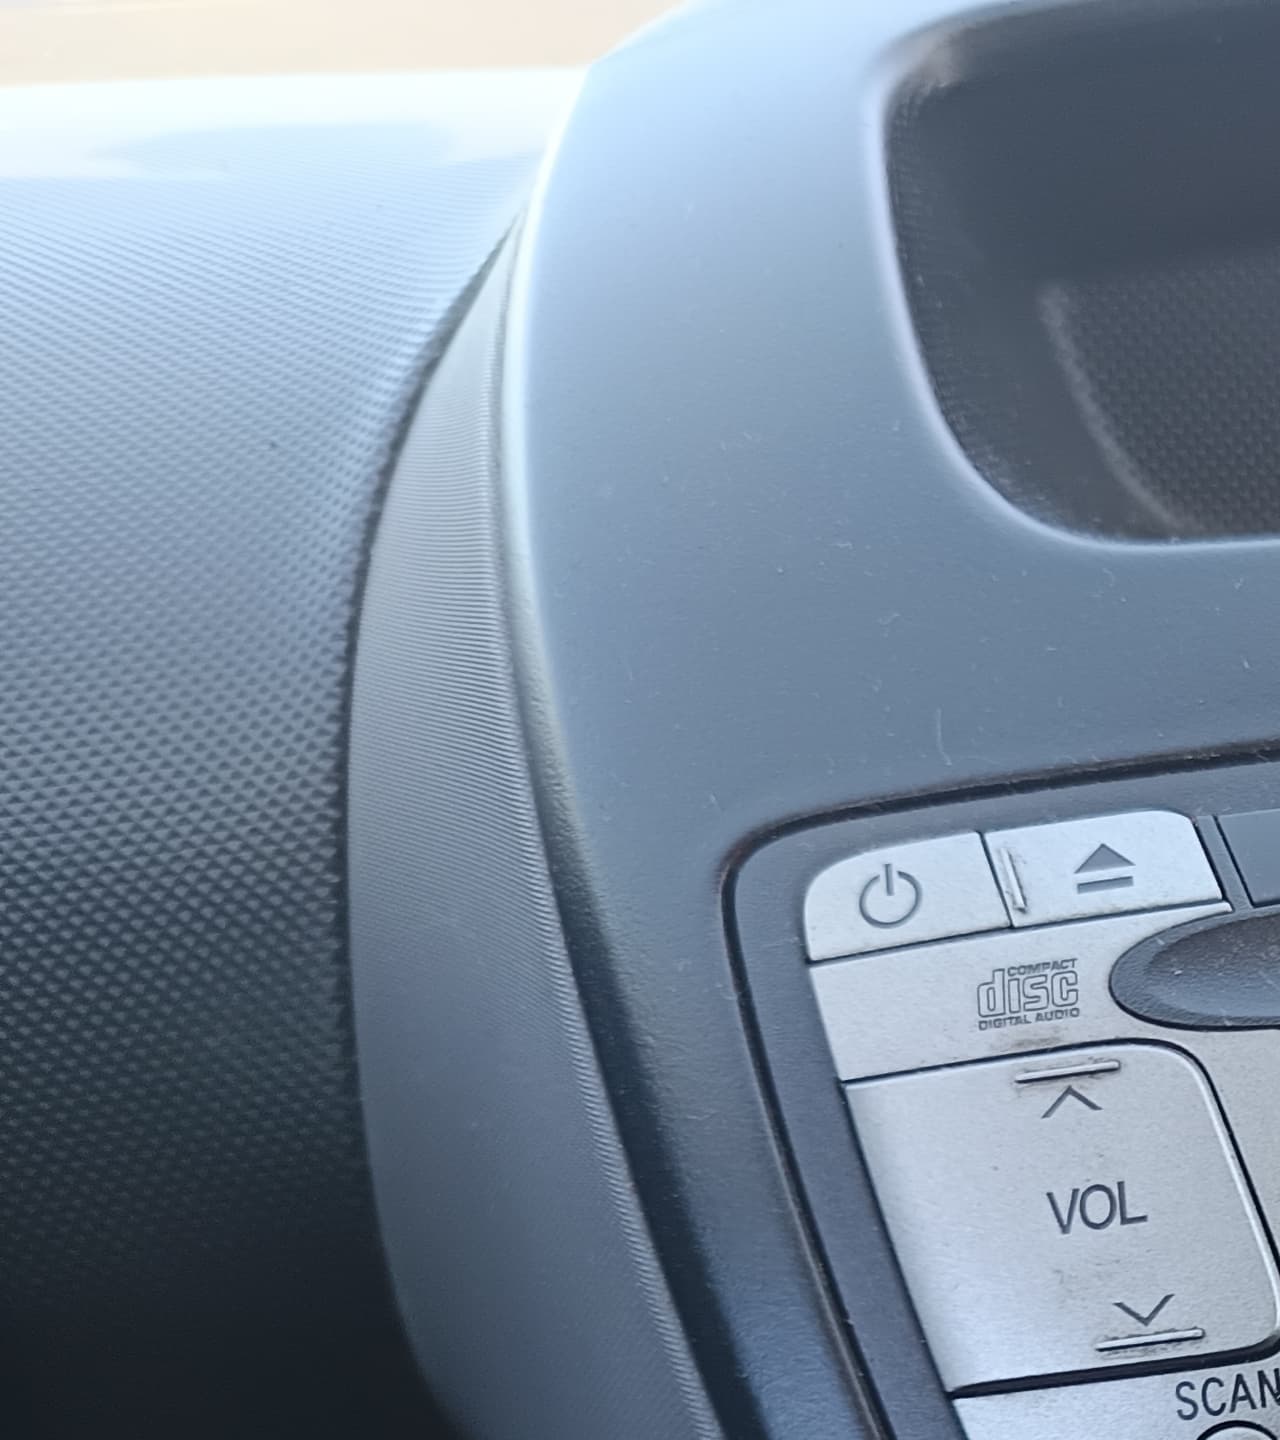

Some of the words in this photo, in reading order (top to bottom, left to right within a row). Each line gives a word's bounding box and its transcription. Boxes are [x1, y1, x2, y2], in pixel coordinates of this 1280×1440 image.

[1007, 958, 1078, 977] COMPACT
[977, 968, 1079, 1018] disc
[978, 1014, 1033, 1031] DIGITAL
[1035, 1007, 1080, 1023] AUDIO
[1046, 1180, 1149, 1235] VOL
